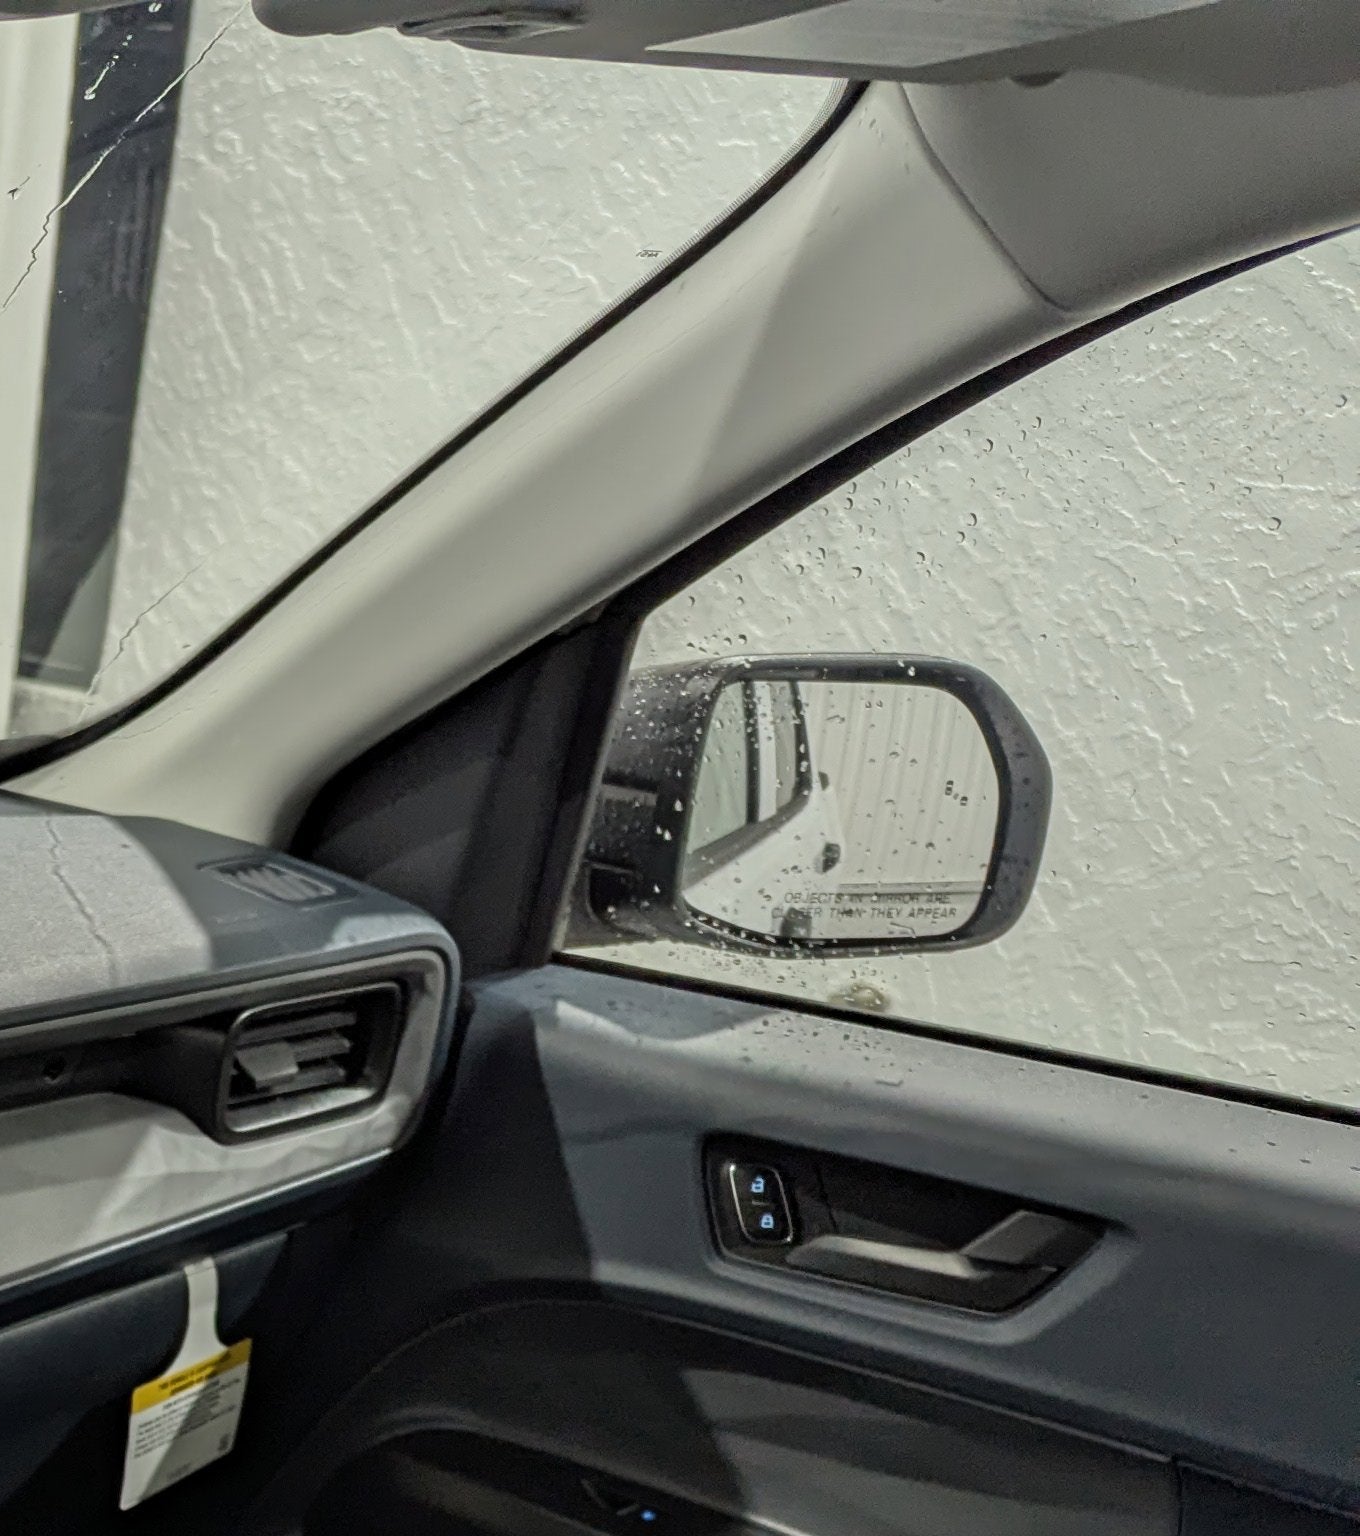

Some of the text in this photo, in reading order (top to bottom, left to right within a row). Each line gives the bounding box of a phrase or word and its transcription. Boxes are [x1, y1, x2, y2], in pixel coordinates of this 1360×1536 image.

[784, 892, 844, 904] OBJECTS
[871, 907, 902, 919] THEY
[908, 907, 957, 918] APPEAR
